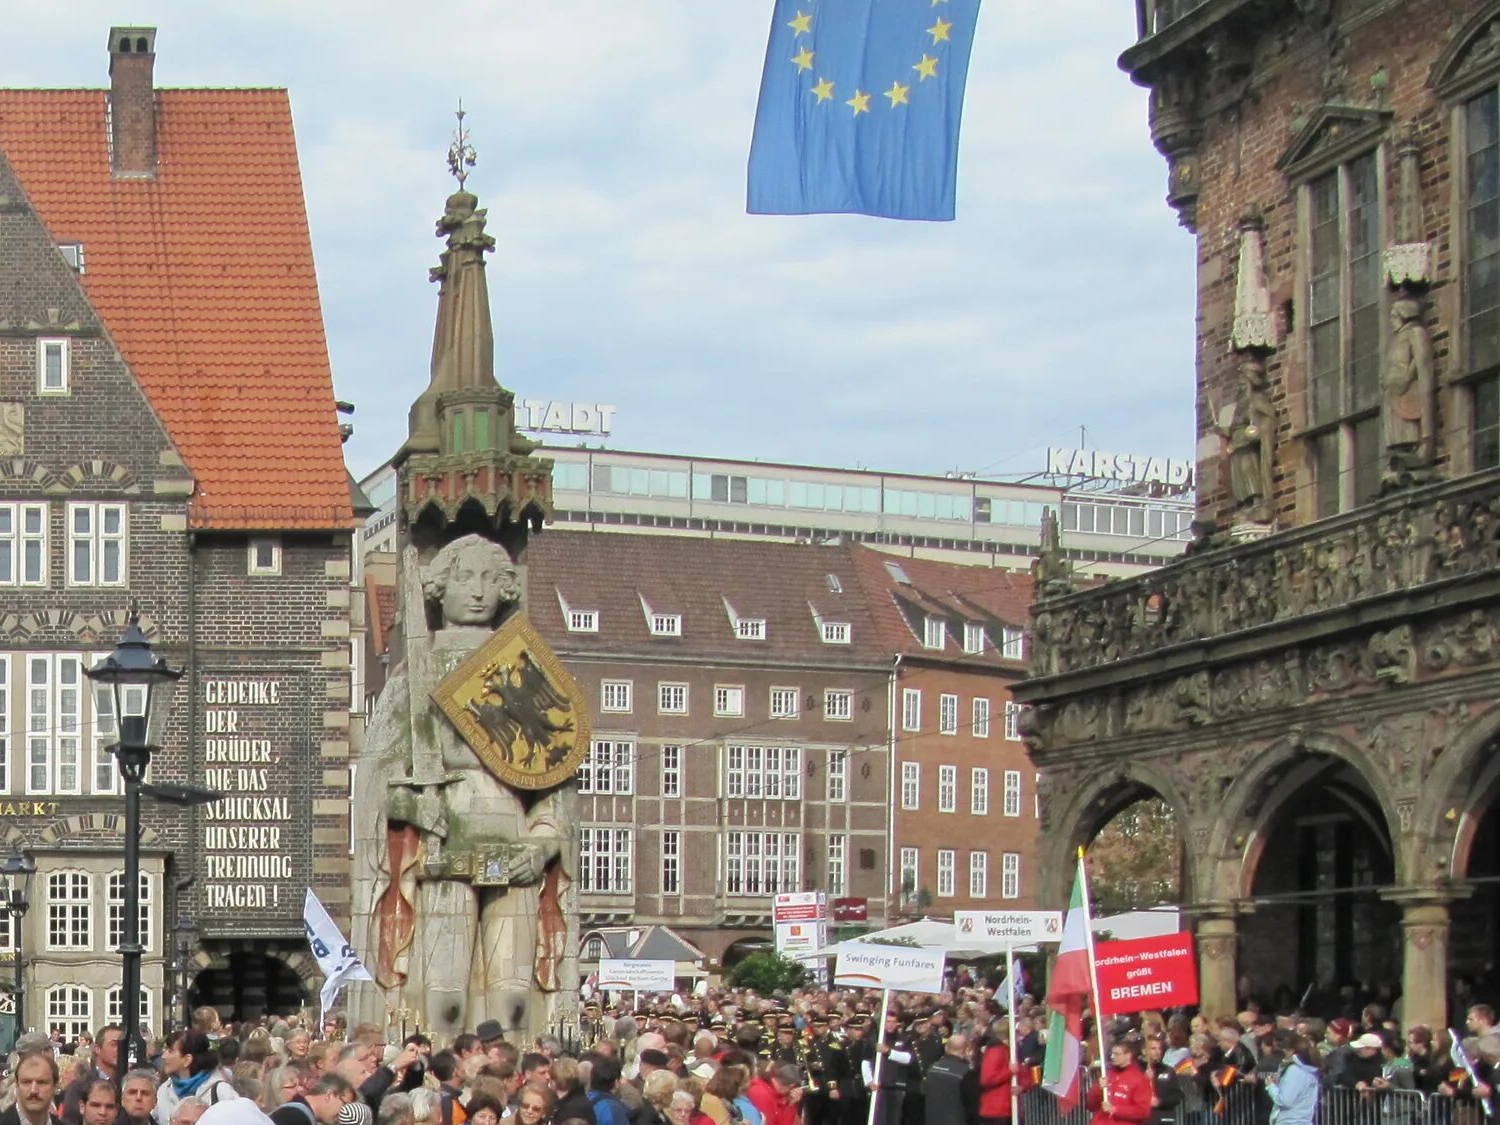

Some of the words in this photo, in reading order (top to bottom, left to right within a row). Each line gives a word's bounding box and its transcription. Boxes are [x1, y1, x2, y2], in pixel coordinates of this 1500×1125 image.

[206, 681, 280, 704] GEDENKE
[206, 710, 237, 733] DER
[206, 769, 231, 791] DIE
[238, 769, 268, 791] DAS
[206, 798, 291, 820] SCHICKSAL
[206, 827, 280, 849] UNSERER
[984, 915, 1033, 924] Nordrhein-
[987, 927, 1032, 936] Westfalen
[845, 953, 891, 967] Swinging
[893, 957, 935, 969] Funfares
[1094, 948, 1187, 966] ordrhein-Westfalen
[1126, 968, 1152, 979] grüßt
[1111, 981, 1172, 1000] BREMEN
